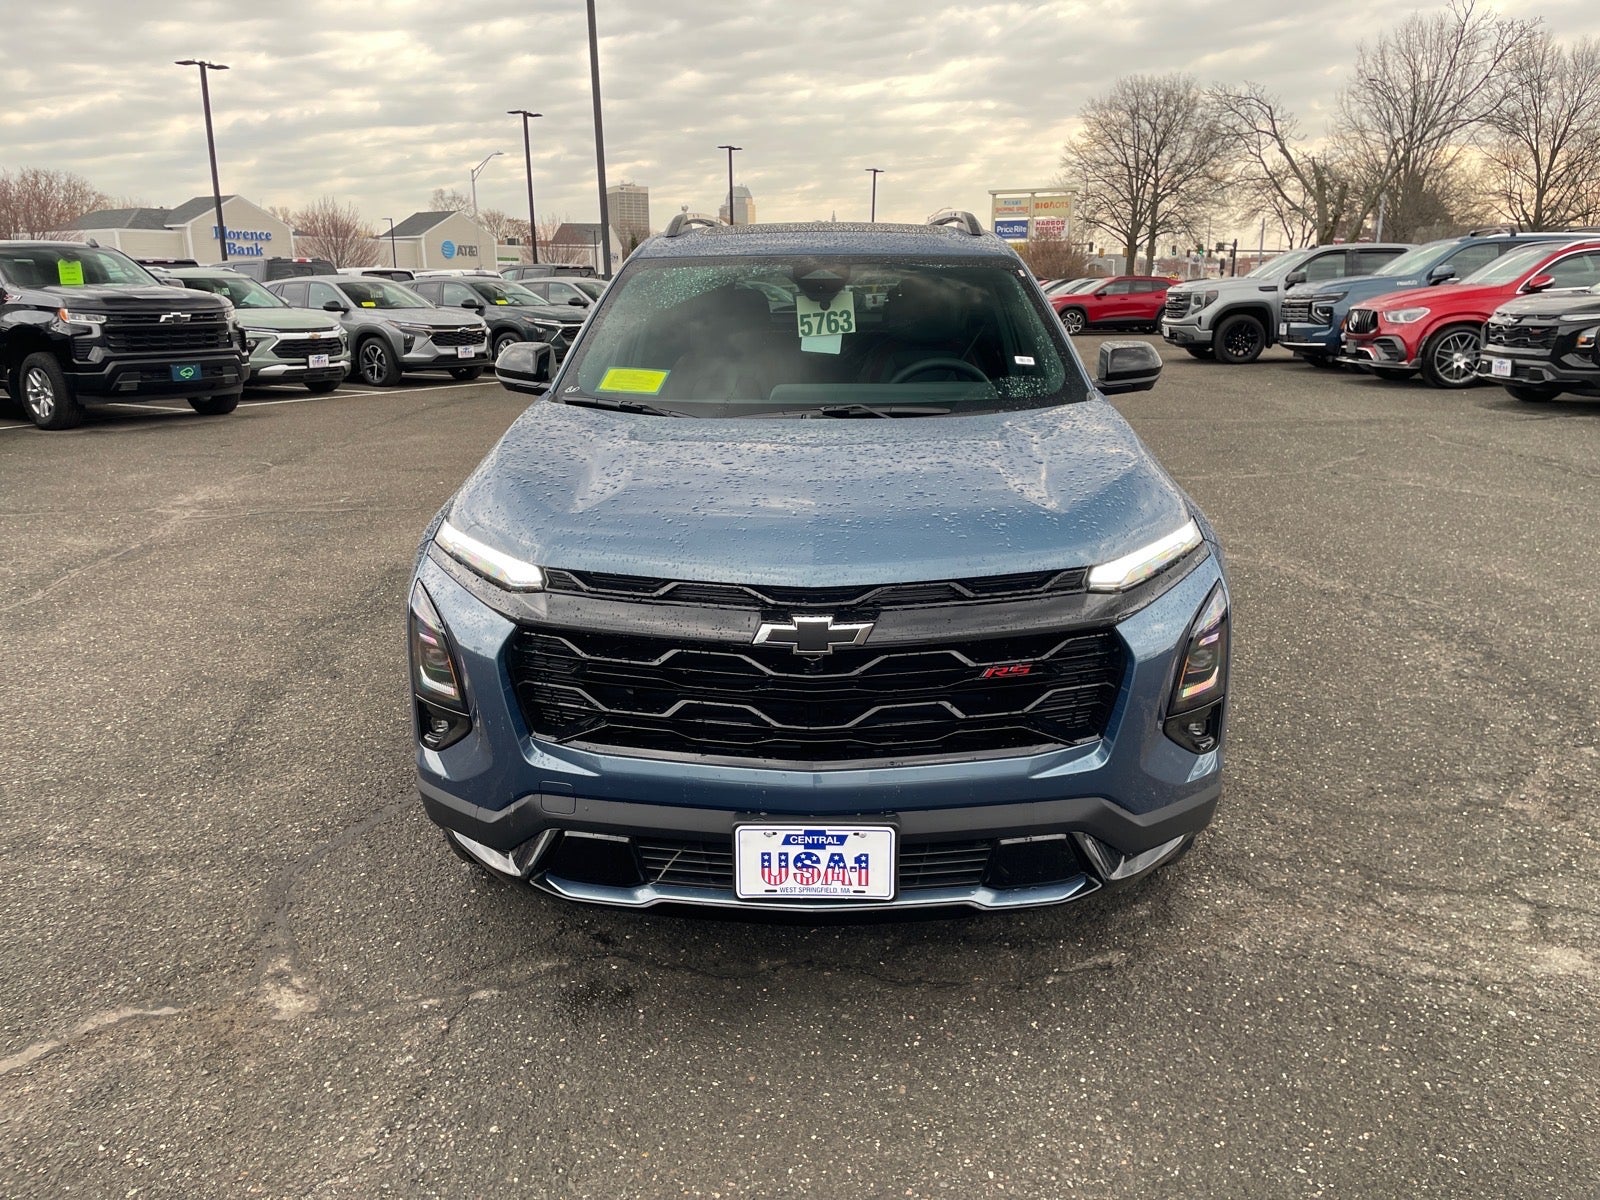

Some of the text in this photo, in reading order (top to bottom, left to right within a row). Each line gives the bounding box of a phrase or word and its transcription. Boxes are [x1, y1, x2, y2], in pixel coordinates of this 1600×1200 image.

[227, 242, 263, 256] Bank
[800, 310, 853, 337] 5763
[980, 665, 1031, 678] RS
[789, 835, 840, 845] CENTRAL
